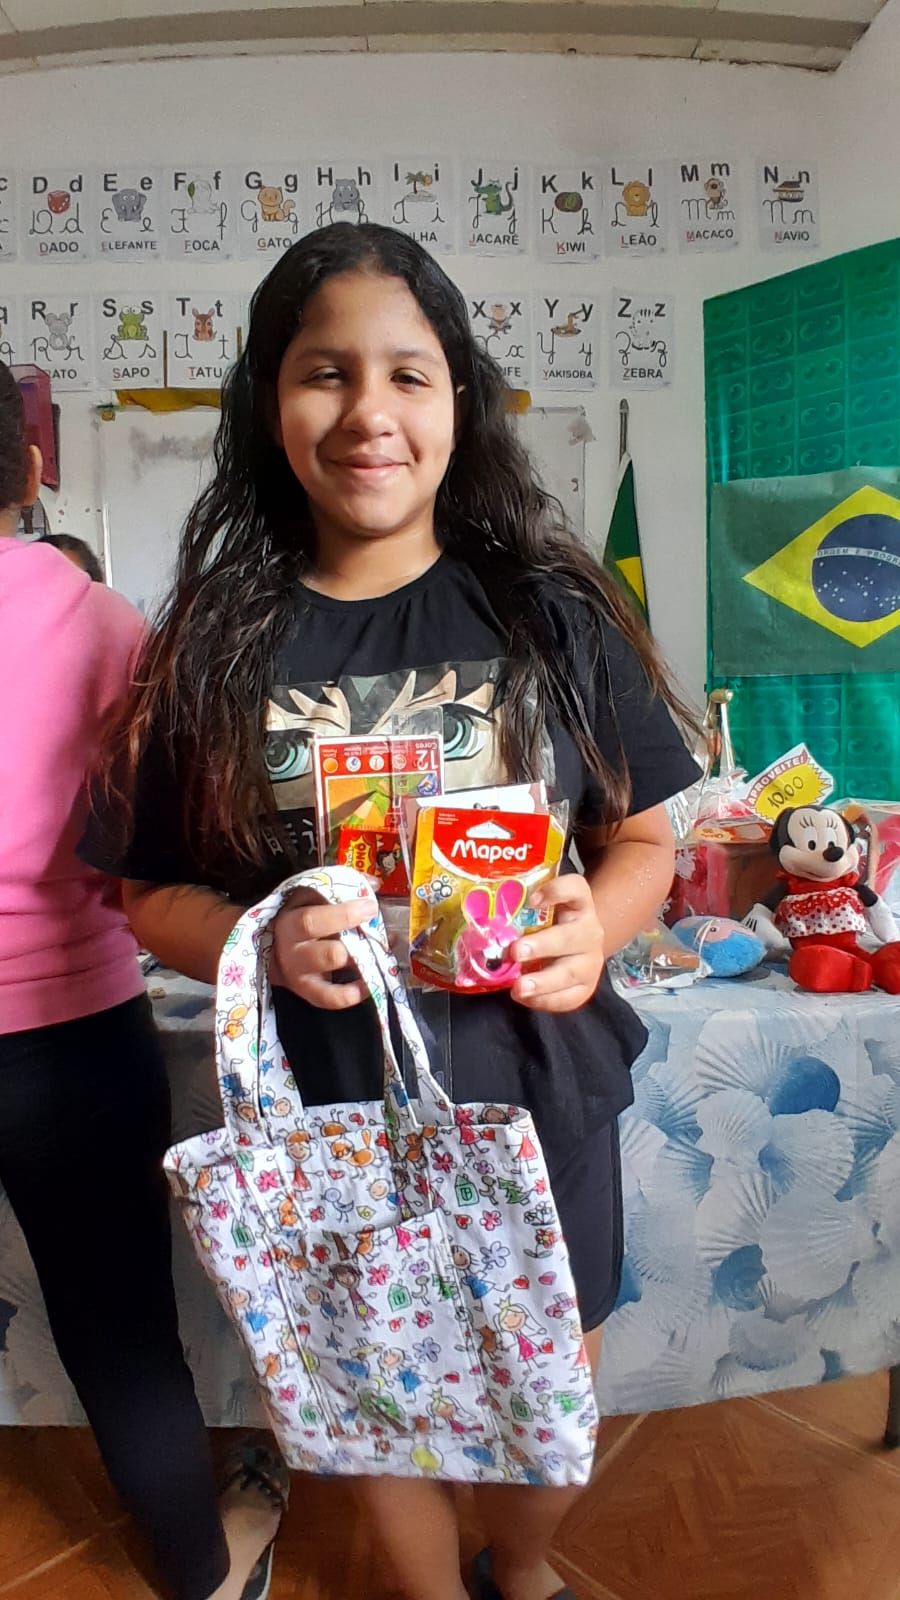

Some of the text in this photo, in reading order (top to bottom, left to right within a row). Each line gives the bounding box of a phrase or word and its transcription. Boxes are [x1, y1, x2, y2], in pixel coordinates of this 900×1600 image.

[174, 172, 221, 190] F f
[318, 167, 370, 186] H h
[435, 164, 439, 181] i
[471, 168, 483, 187] J
[612, 168, 623, 185] L
[682, 164, 730, 182] M m
[764, 166, 810, 183] N n
[33, 175, 82, 194] D d
[104, 174, 152, 191] E e
[245, 172, 297, 192] G g
[541, 171, 594, 192] K k
[257, 238, 292, 248] GATO
[621, 233, 657, 246] LEÃO
[686, 230, 734, 240] MACACO
[774, 231, 810, 241] NAVIO
[39, 241, 79, 253] DADO
[101, 240, 157, 251] ELEFANTE
[184, 240, 220, 251] FOCA
[557, 241, 585, 253] KIWI
[32, 301, 45, 320] R
[103, 299, 116, 317] S
[176, 298, 223, 317] T t
[545, 298, 593, 322] Y y
[618, 298, 666, 318] Z z
[112, 367, 150, 378] SAPO
[189, 367, 222, 378] TATU
[543, 369, 593, 379] YAKISOBA
[623, 368, 663, 379] ZEBRA
[416, 750, 439, 770] 12
[749, 756, 805, 804] APROVEITE!
[451, 839, 528, 863] Maped
